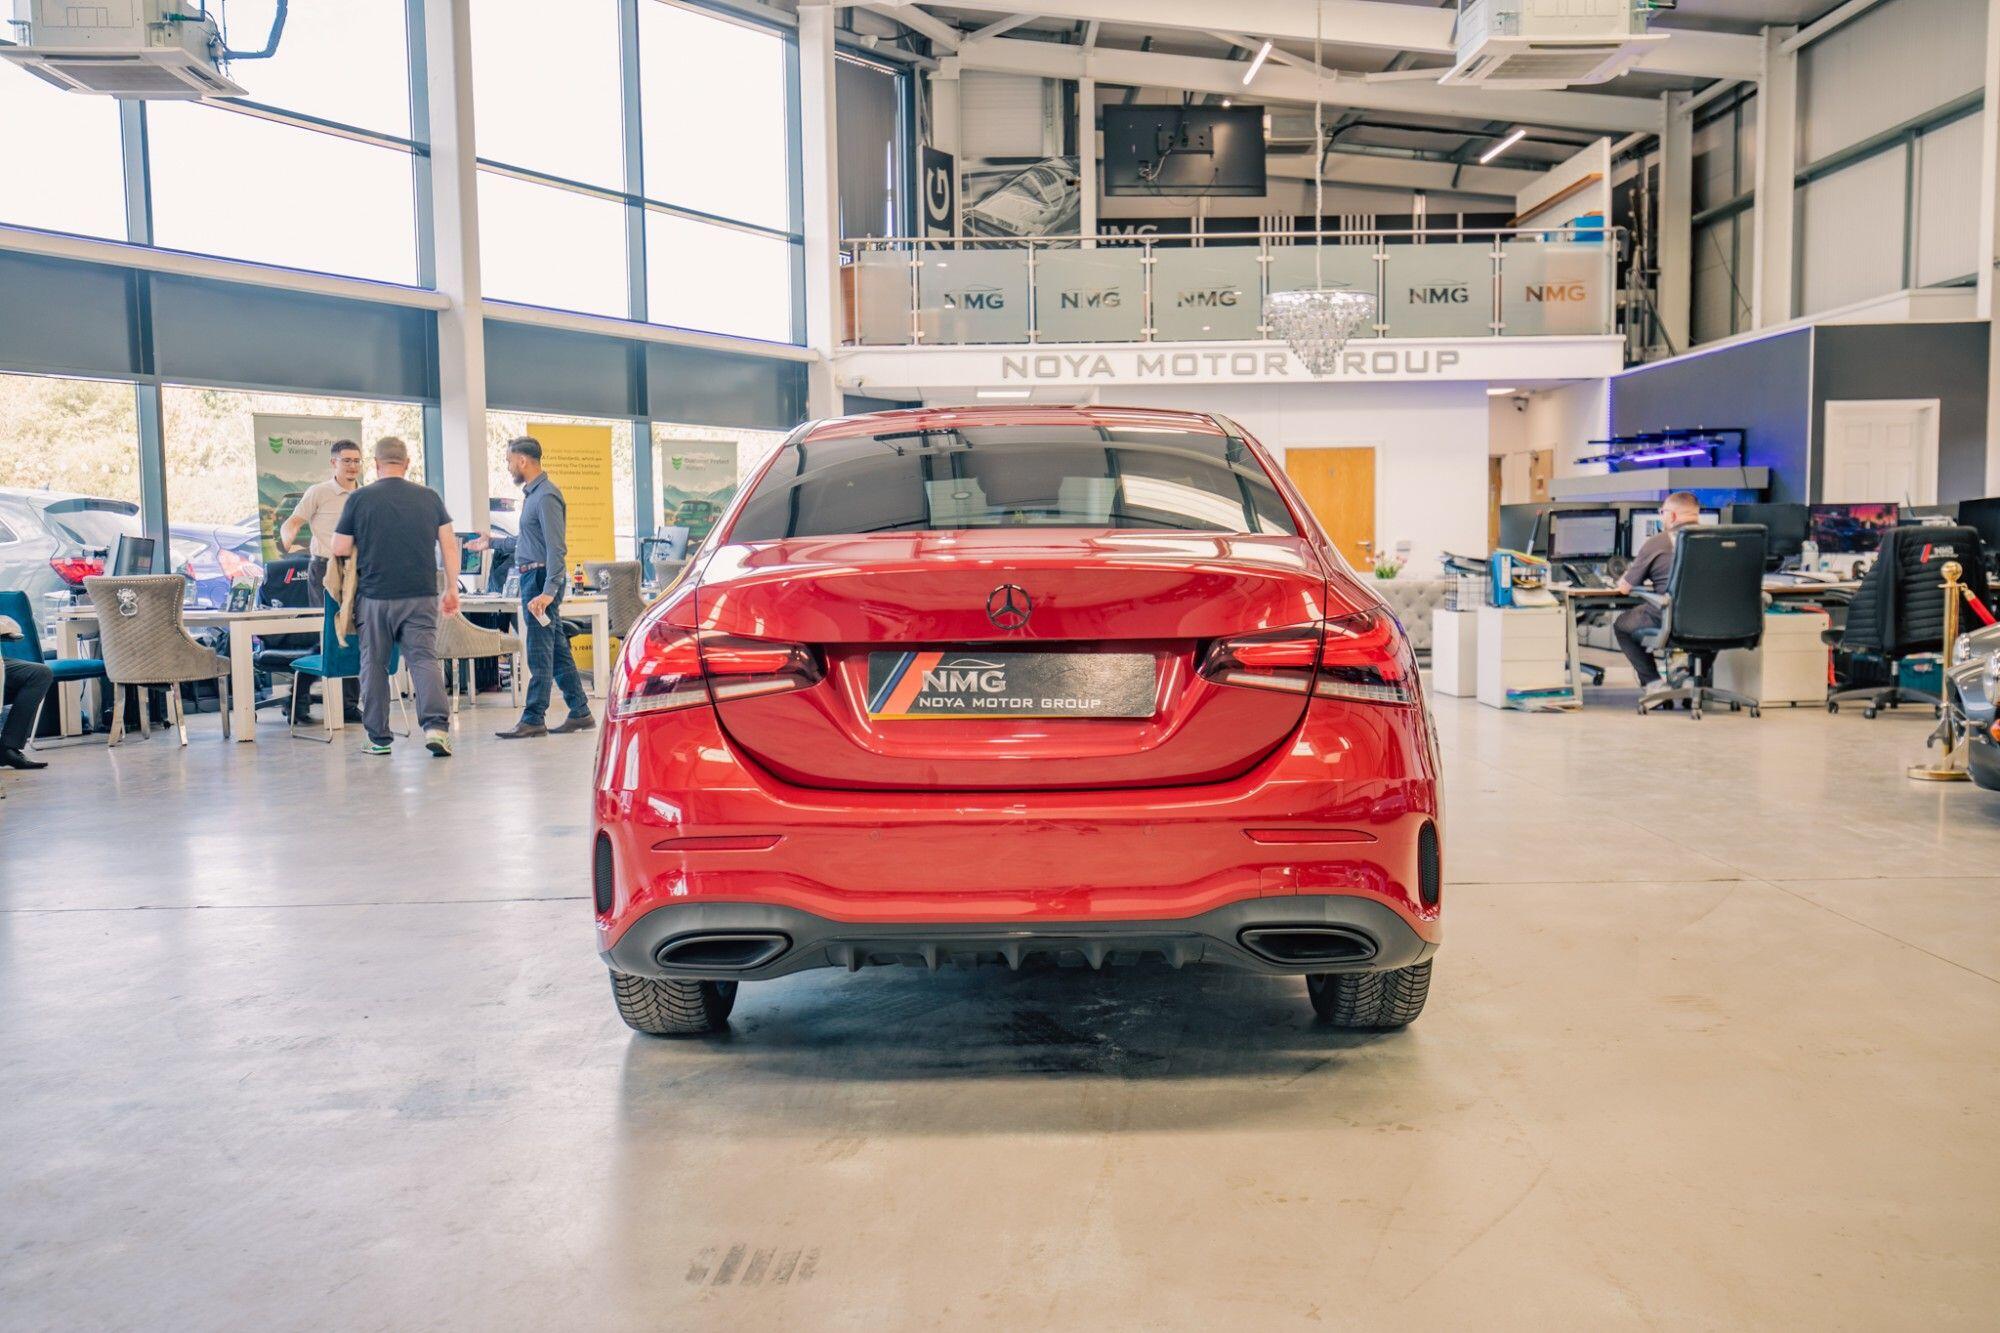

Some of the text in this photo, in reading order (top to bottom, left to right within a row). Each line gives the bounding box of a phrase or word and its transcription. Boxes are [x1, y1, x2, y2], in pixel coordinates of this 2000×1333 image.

[944, 293, 1003, 309] NMG
[1061, 292, 1120, 309] NMG
[1177, 290, 1237, 308] NMG
[1409, 287, 1469, 304] NMG
[1525, 285, 1586, 302] NMG
[1002, 354, 1115, 379] NOYA
[1137, 352, 1289, 377] MOTOR
[922, 669, 1006, 692] NMG
[920, 697, 1101, 708] NOYA MOTOR GROUP
